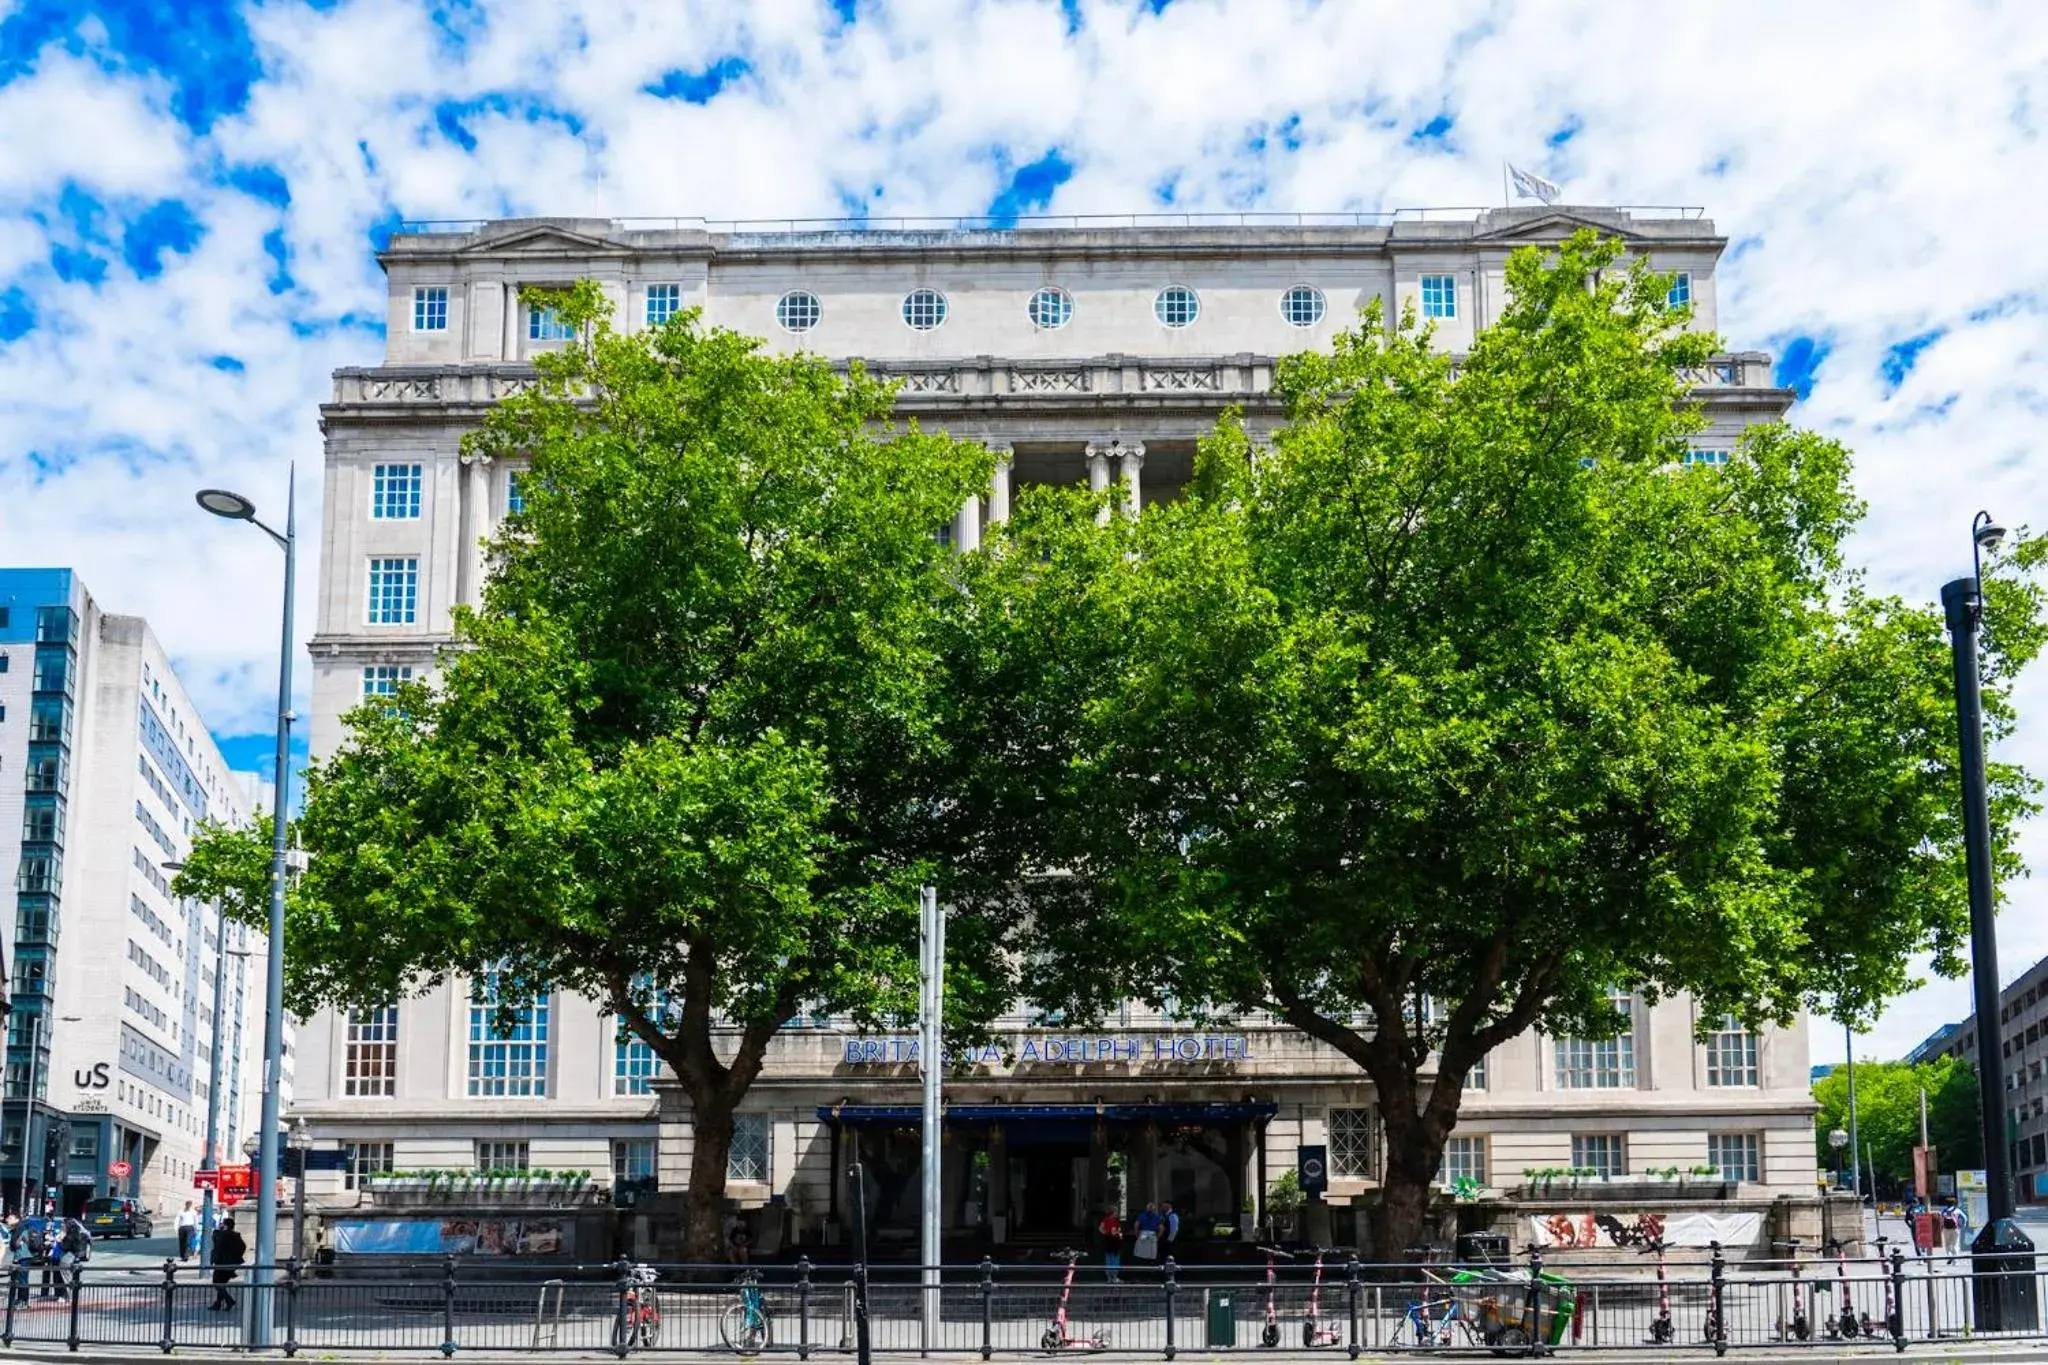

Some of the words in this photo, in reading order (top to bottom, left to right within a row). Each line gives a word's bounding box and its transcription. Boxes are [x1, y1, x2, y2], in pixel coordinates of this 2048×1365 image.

[847, 1040, 1001, 1063] BRITAIA
[1021, 1038, 1140, 1062] ADELPHI
[1155, 1037, 1253, 1061] HOTEL
